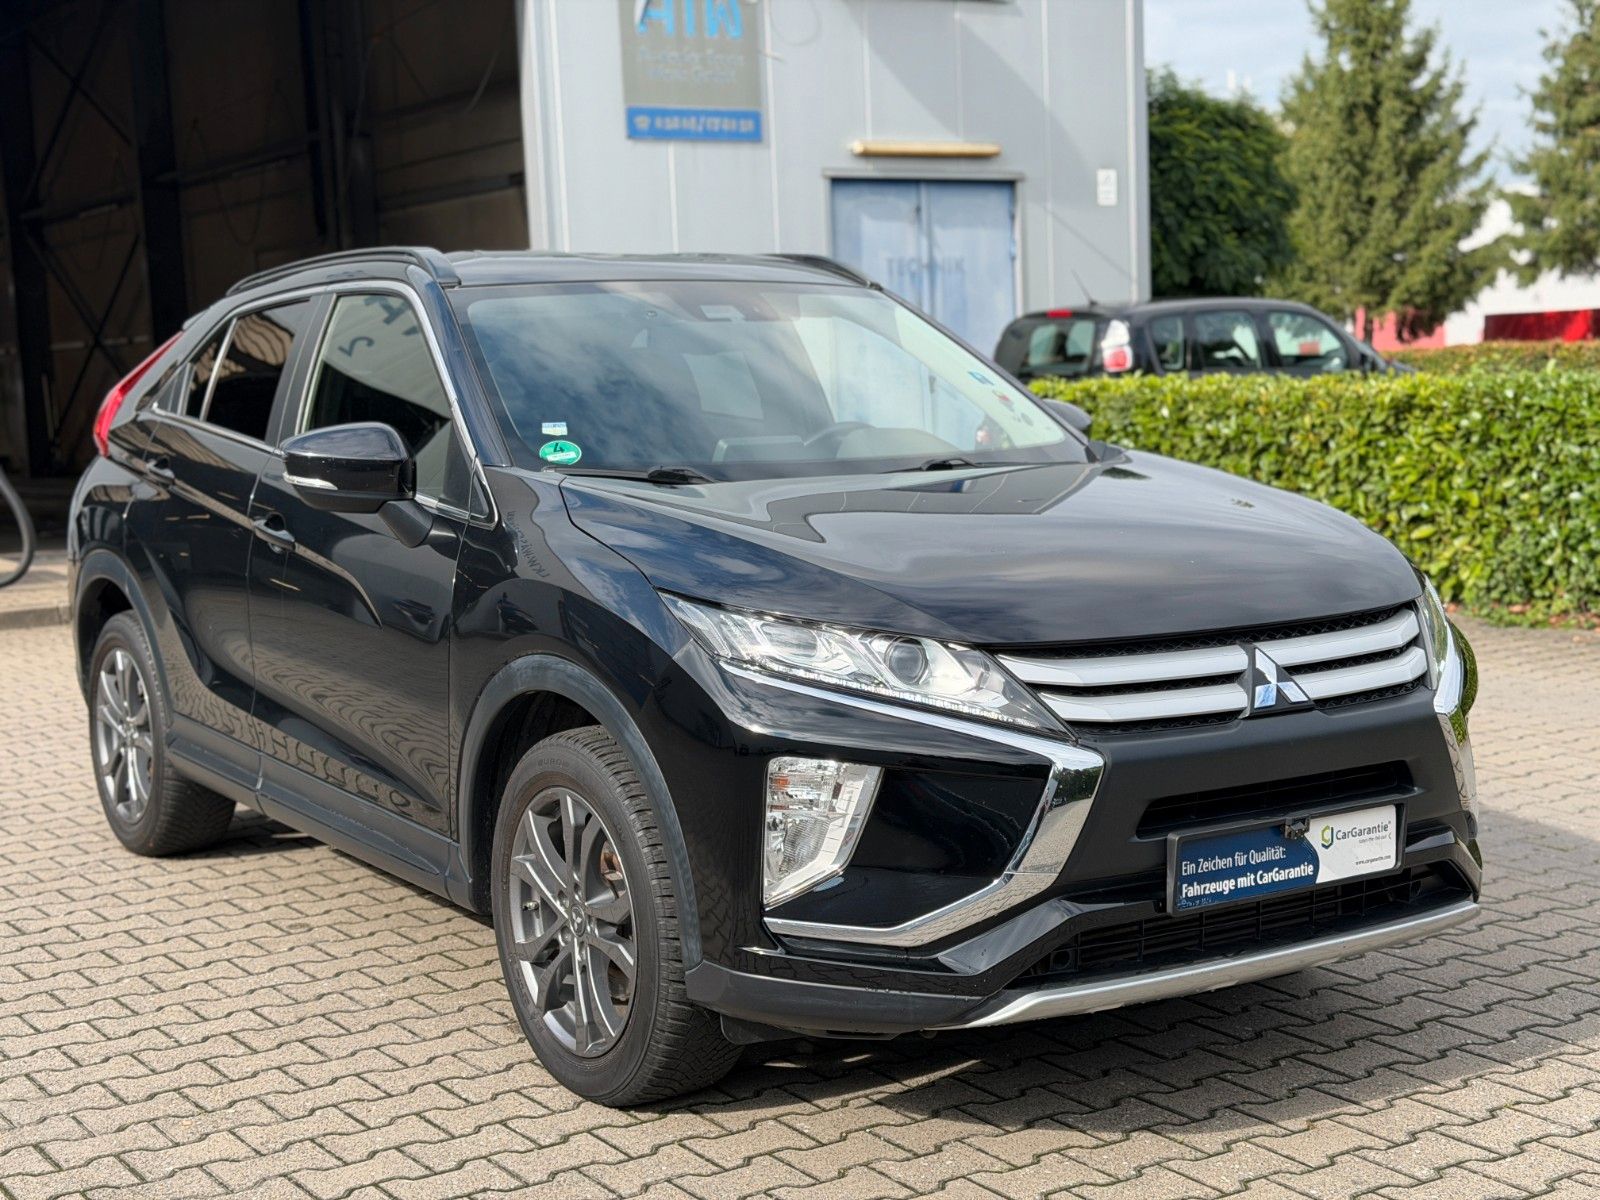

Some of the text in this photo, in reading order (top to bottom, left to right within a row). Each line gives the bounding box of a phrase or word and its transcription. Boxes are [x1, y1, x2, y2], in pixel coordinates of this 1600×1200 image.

[553, 442, 565, 453] 4
[1182, 845, 1287, 876] Ein Zeichen für Qualität:
[1182, 861, 1314, 898] Fahrzeuge mit CarGarantie
